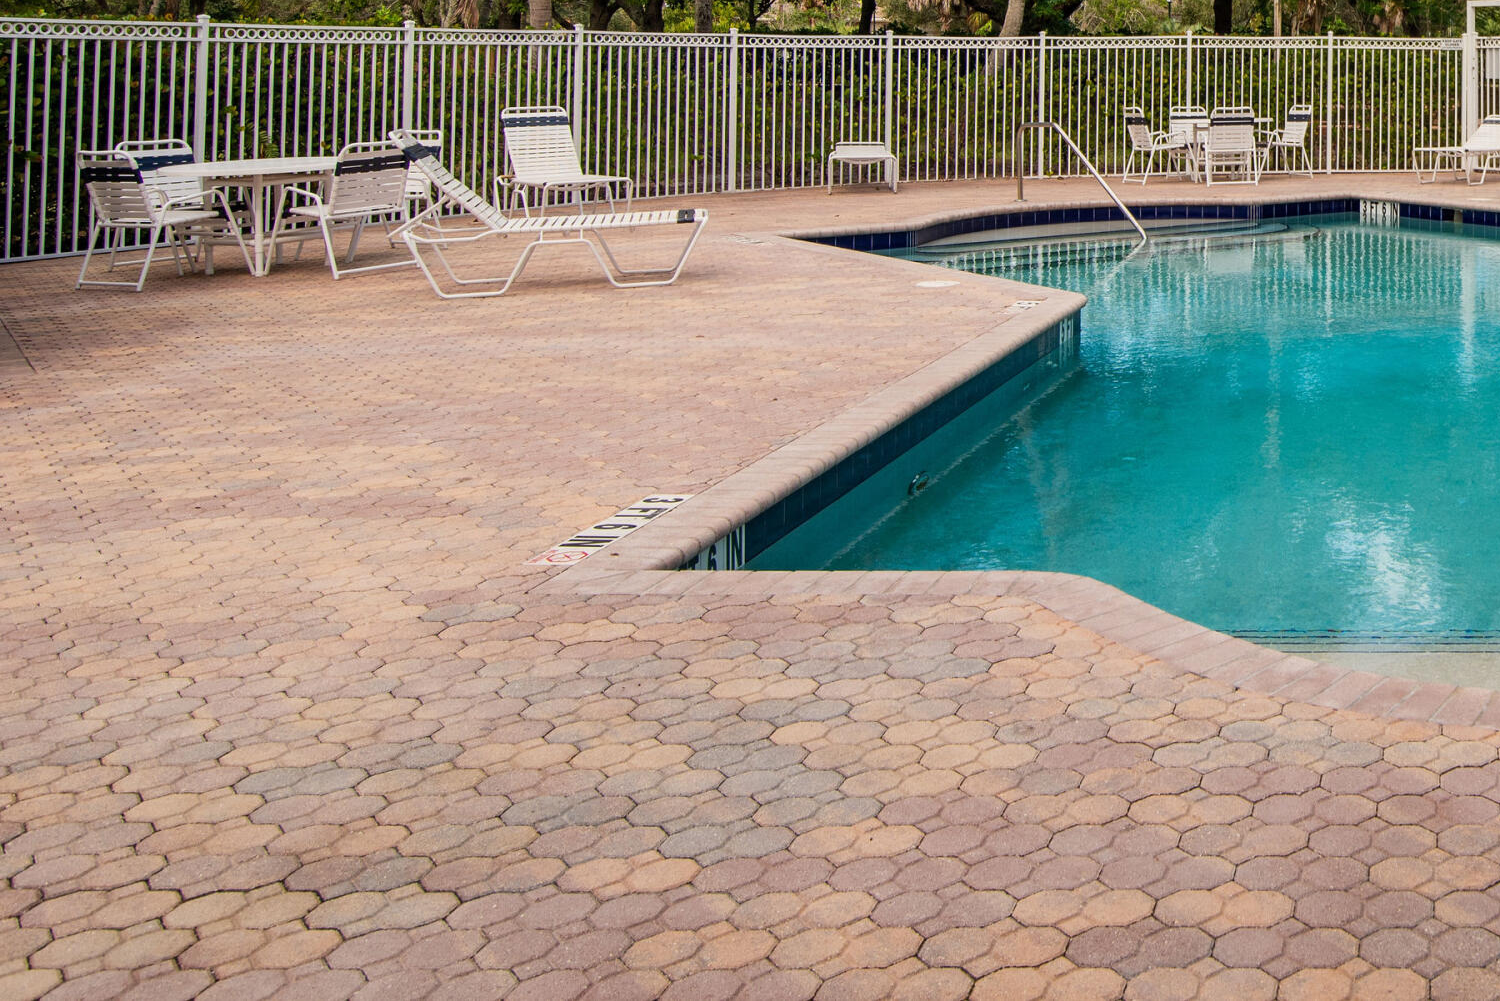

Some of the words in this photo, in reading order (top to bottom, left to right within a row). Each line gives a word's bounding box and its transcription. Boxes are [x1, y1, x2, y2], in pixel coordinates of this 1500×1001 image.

[1370, 201, 1379, 215] FT
[614, 507, 669, 519] FT
[558, 535, 621, 548] IN
